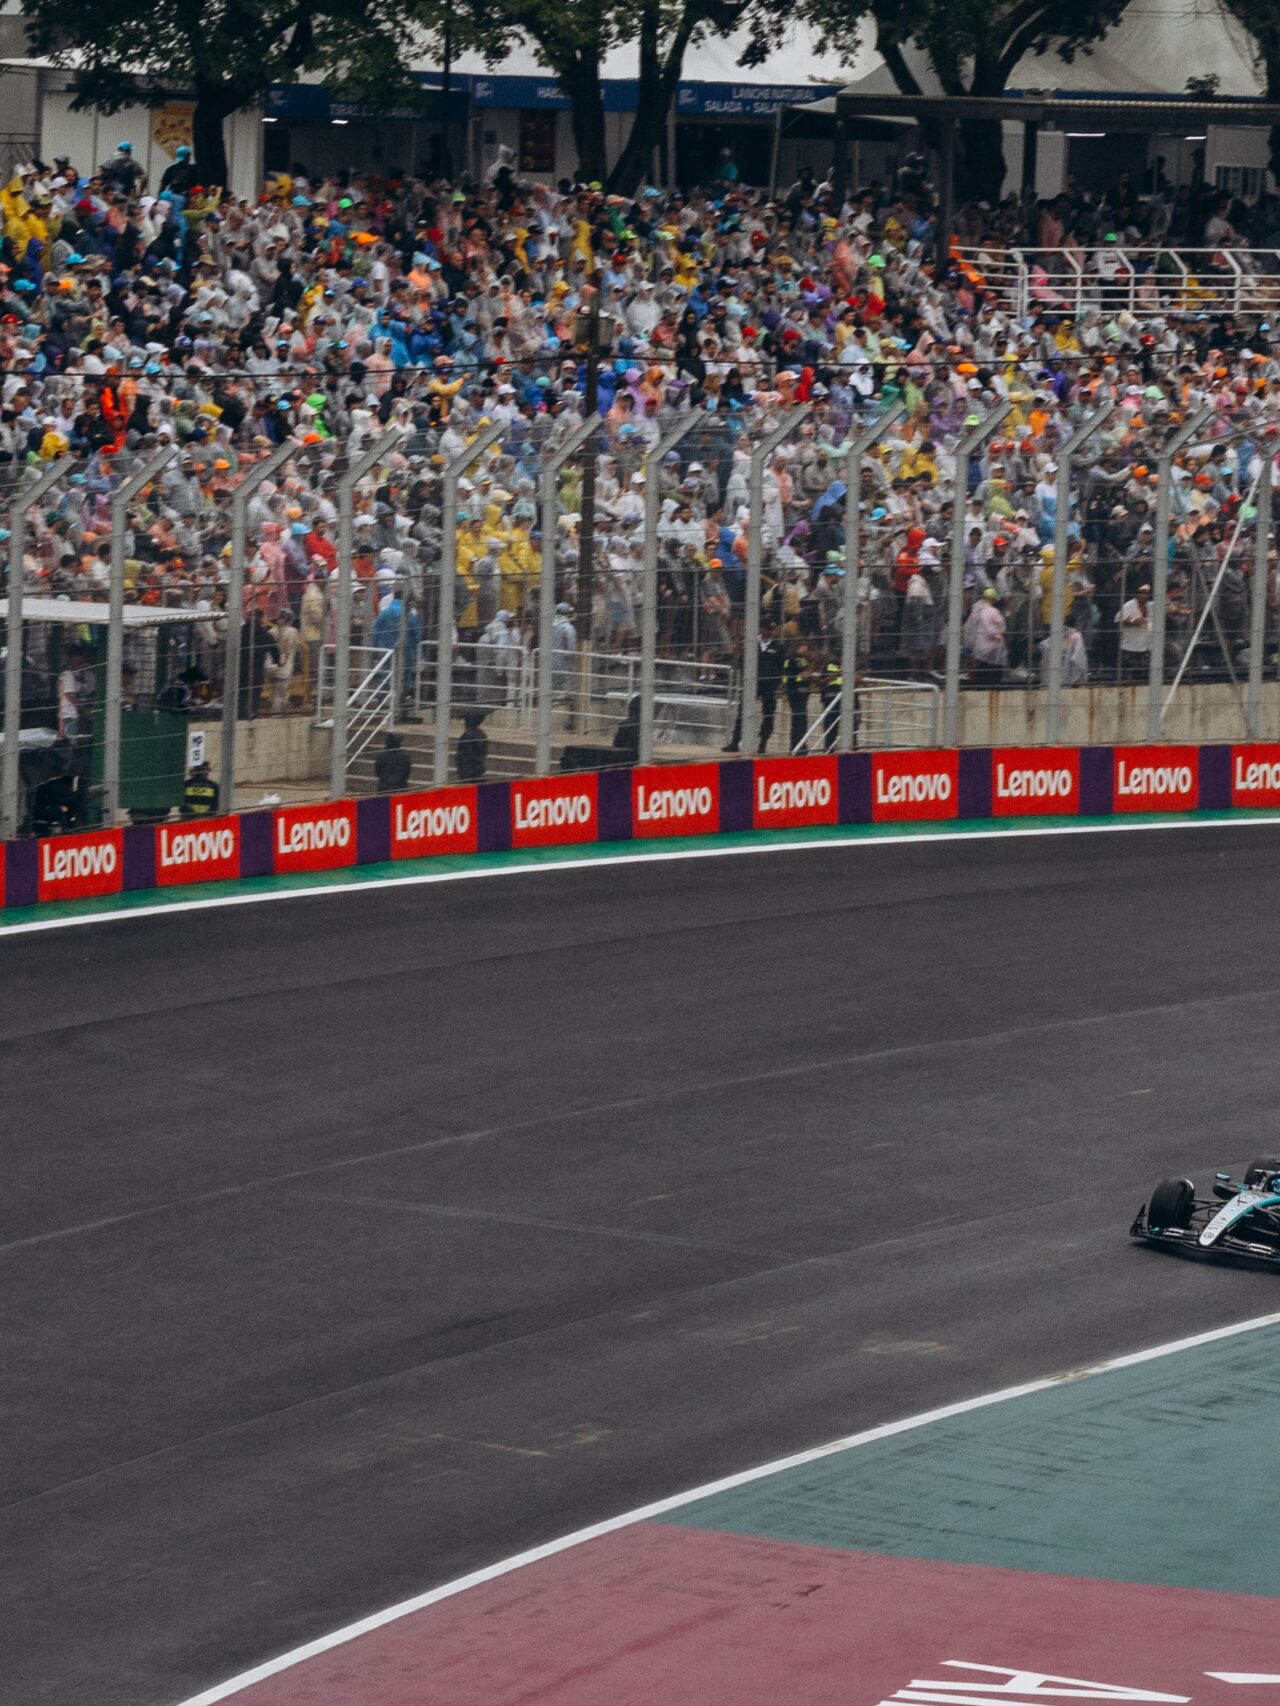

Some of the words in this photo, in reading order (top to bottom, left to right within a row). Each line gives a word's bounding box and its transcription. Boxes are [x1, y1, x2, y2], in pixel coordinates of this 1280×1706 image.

[758, 776, 831, 811] Lenovo
[877, 769, 951, 804] Lenovo
[997, 763, 1072, 798] Lenovo
[1118, 761, 1192, 795] Lenovo
[514, 793, 591, 829] Lenovo
[637, 785, 712, 821] Lenovo
[278, 817, 351, 854] Lenovo
[395, 804, 470, 841] Lenovo
[43, 843, 117, 882] Lenovo
[160, 829, 234, 867] Lenovo
